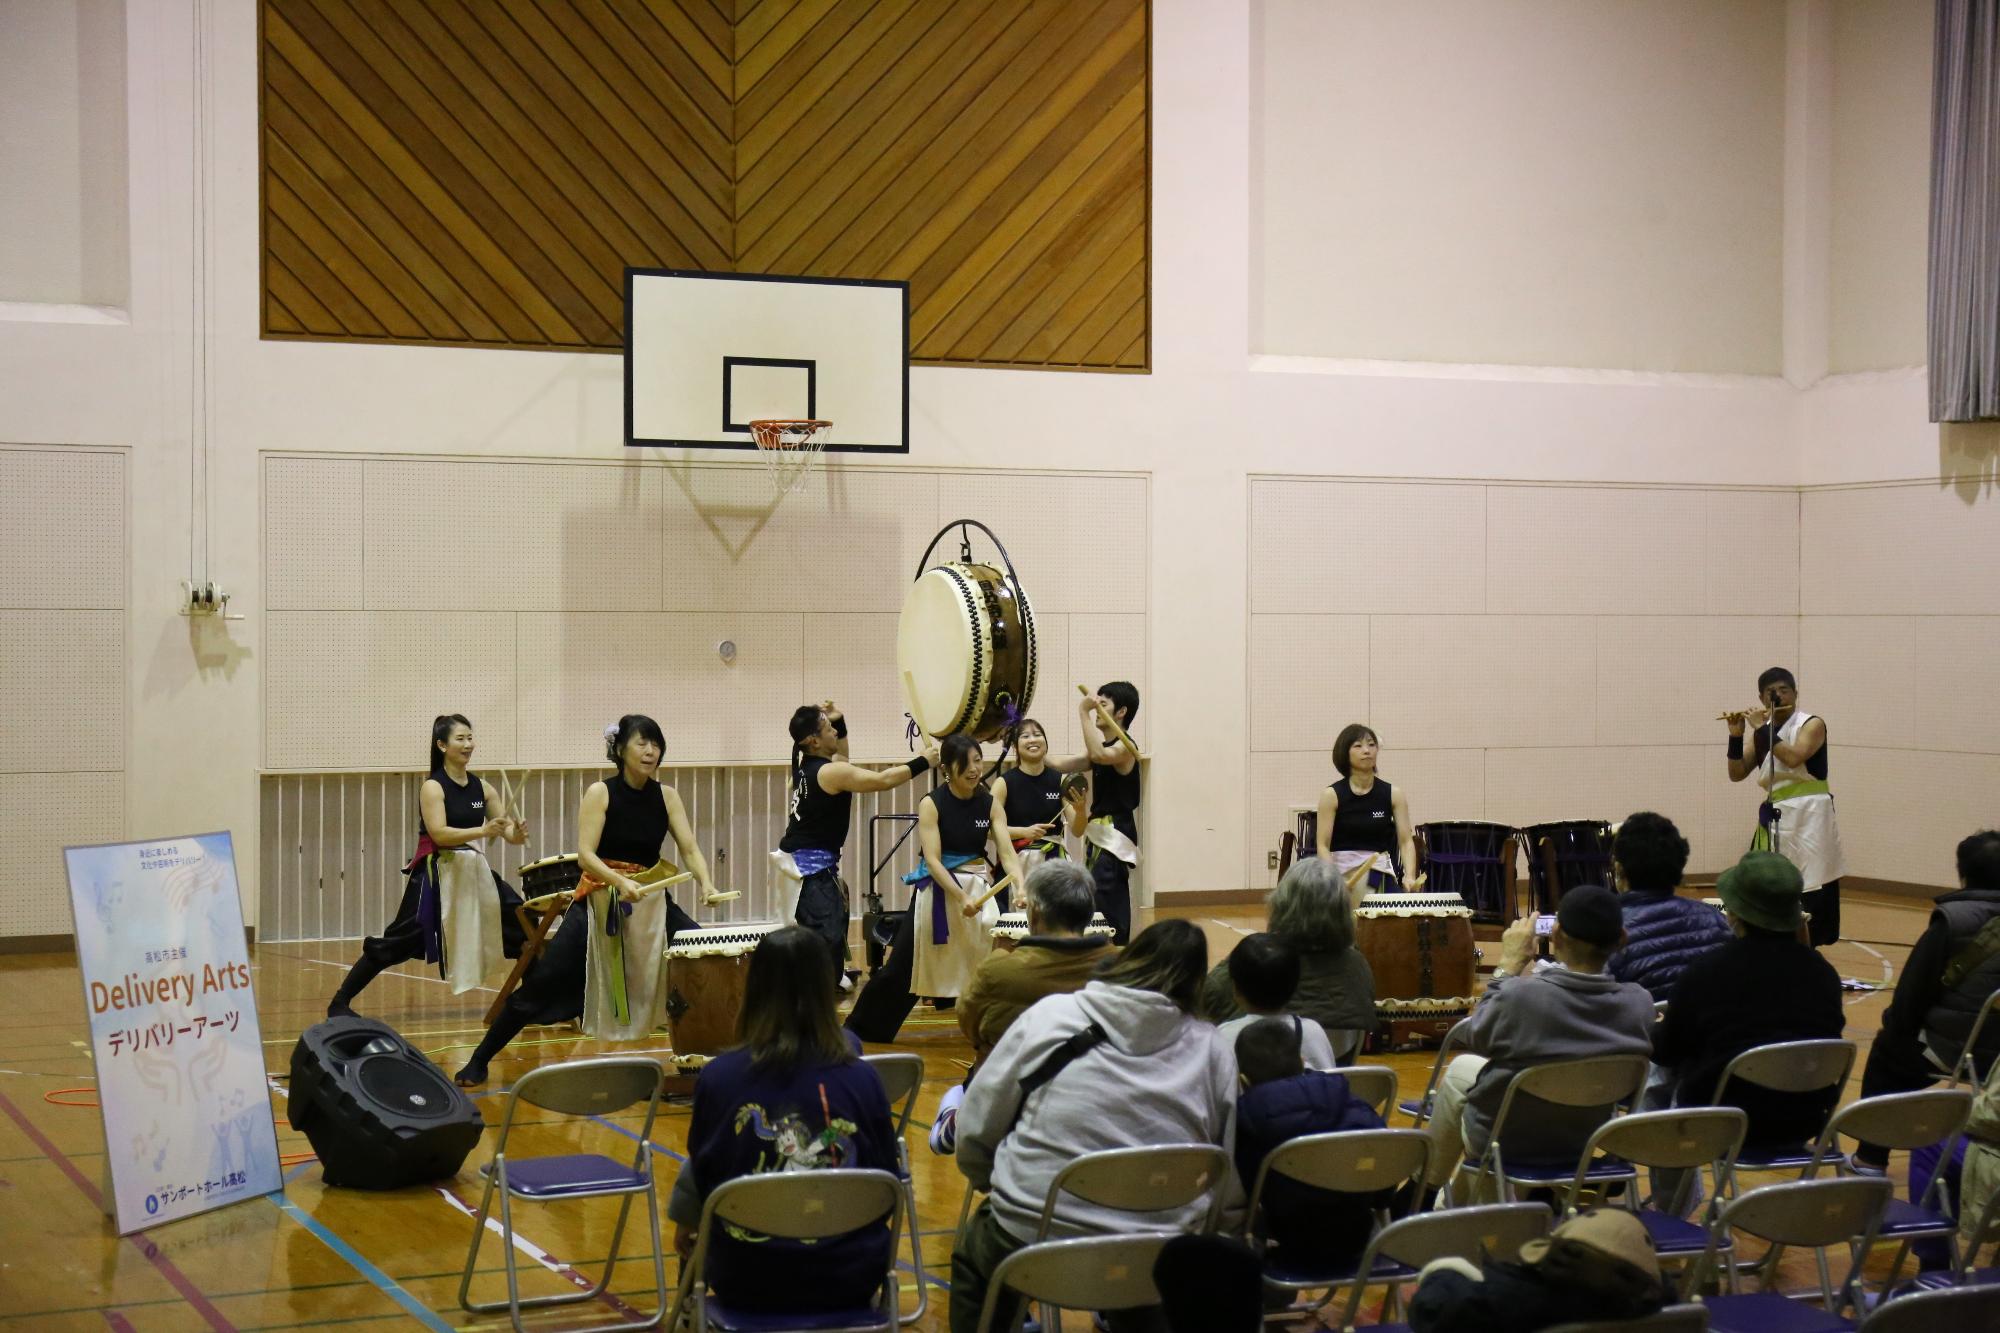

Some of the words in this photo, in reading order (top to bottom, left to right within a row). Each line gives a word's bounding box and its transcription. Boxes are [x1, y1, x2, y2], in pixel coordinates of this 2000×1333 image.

[145, 946, 188, 963] 高松市主催
[91, 973, 194, 1013] Delivery
[203, 961, 250, 994] Arts
[108, 1011, 239, 1056] デリバリーアーツ
[161, 1170, 246, 1205] サンポートホール高松
